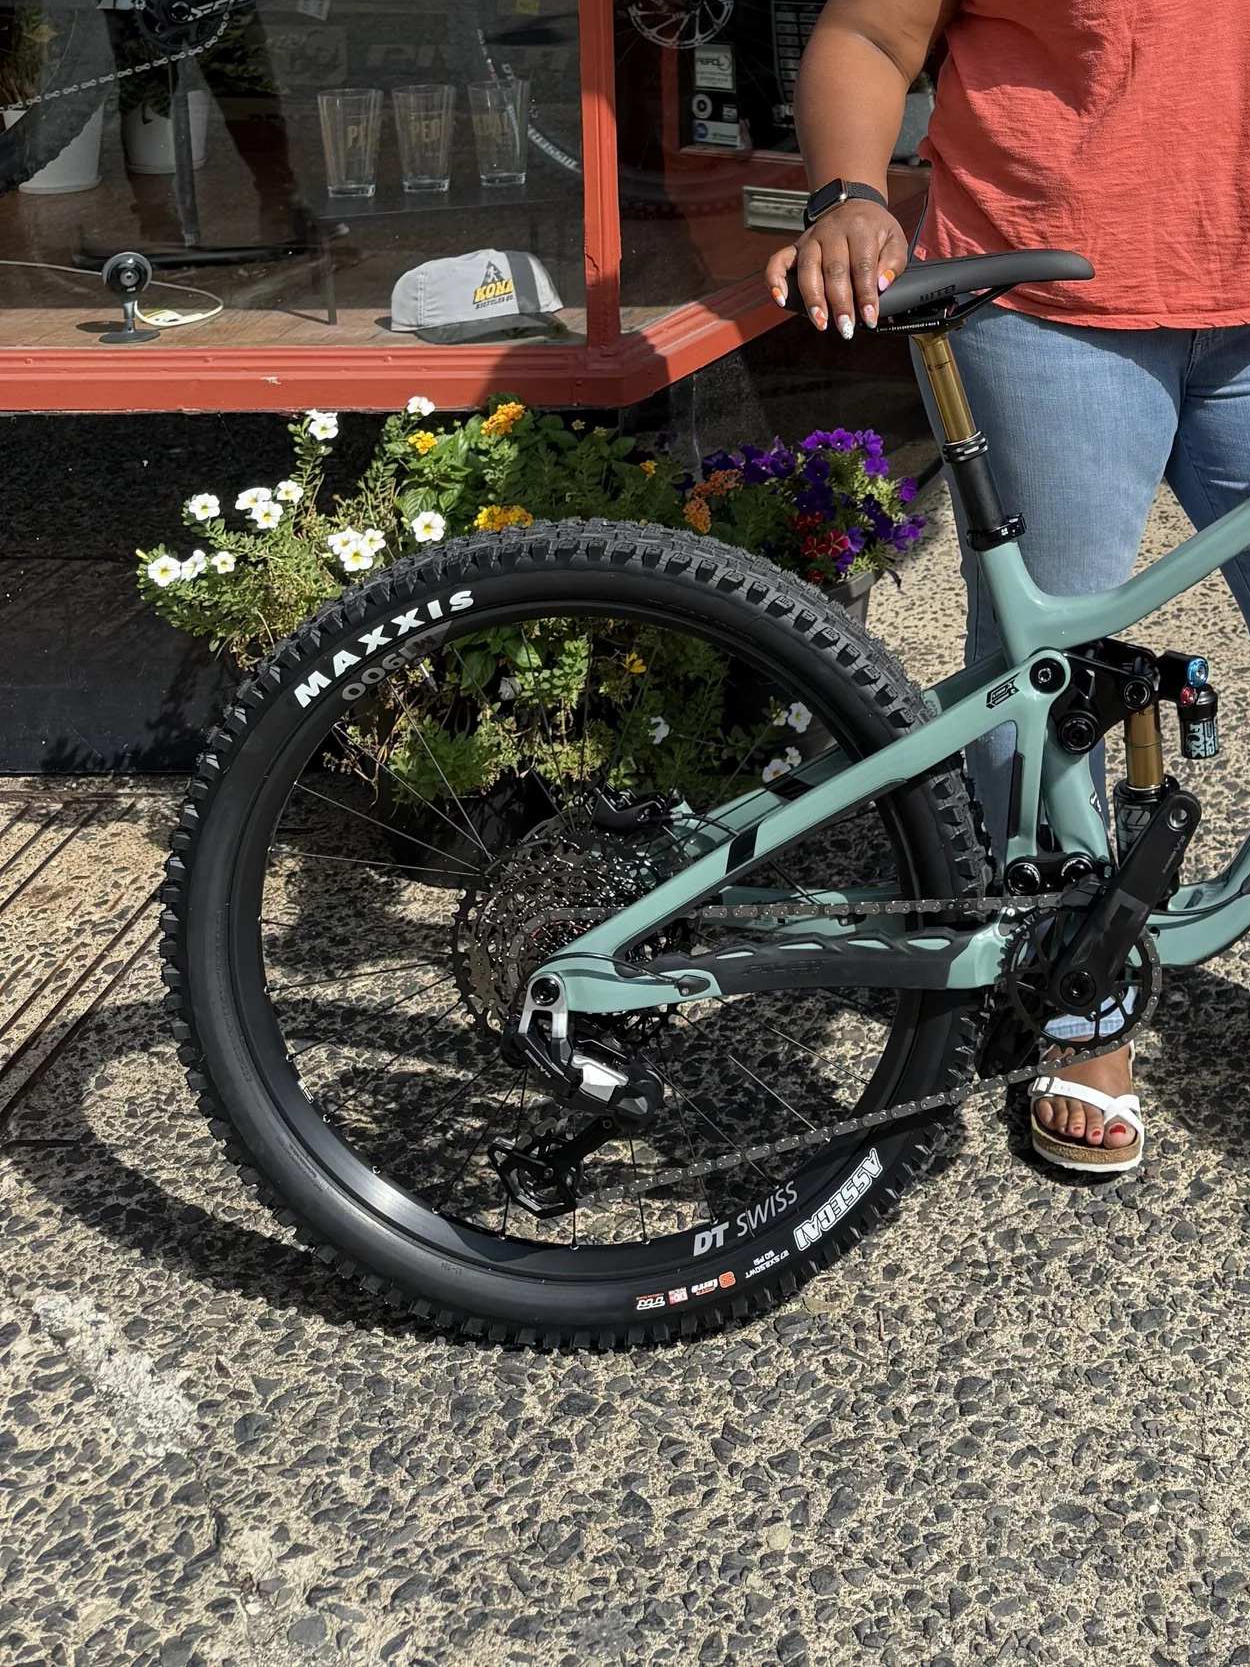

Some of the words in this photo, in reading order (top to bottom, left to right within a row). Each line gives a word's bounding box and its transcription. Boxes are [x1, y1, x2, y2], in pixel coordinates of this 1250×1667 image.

[293, 590, 475, 709] MAXXIS
[341, 634, 438, 701] M1900
[1188, 722, 1205, 758] FOX
[693, 1221, 730, 1257] DT
[735, 1180, 798, 1238] SWISS
[792, 1147, 883, 1252] ASSEGAI
